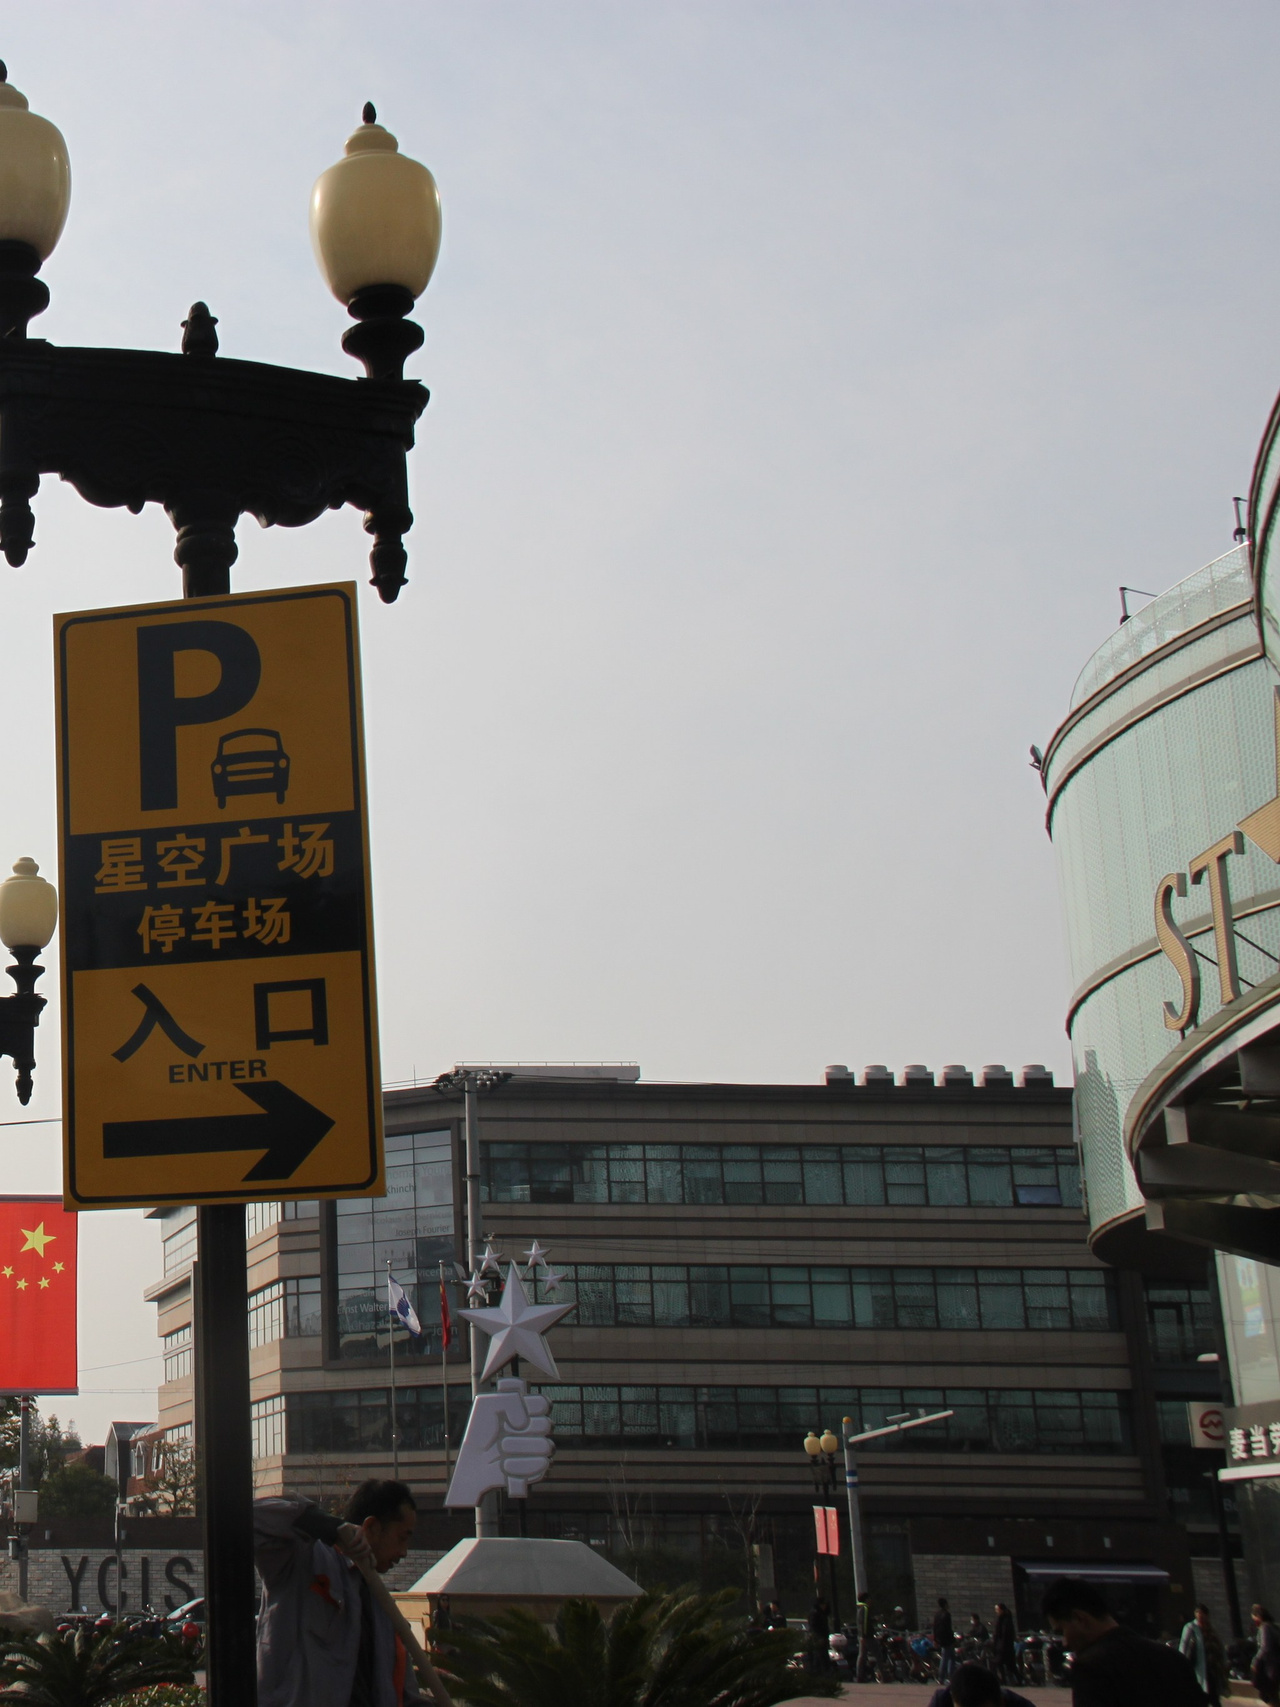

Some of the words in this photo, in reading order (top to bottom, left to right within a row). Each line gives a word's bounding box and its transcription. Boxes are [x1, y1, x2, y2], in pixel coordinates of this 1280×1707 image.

[137, 619, 262, 812] P
[94, 823, 336, 895] 星空广场
[136, 897, 292, 955] 停车场
[1154, 830, 1244, 1032] ST
[112, 976, 330, 1065] 入口
[168, 1058, 268, 1084] ENTER
[422, 1224, 451, 1234] Fourier
[359, 1302, 387, 1313] Walter
[431, 1324, 458, 1337] Jon
[61, 1555, 195, 1613] YCIS
